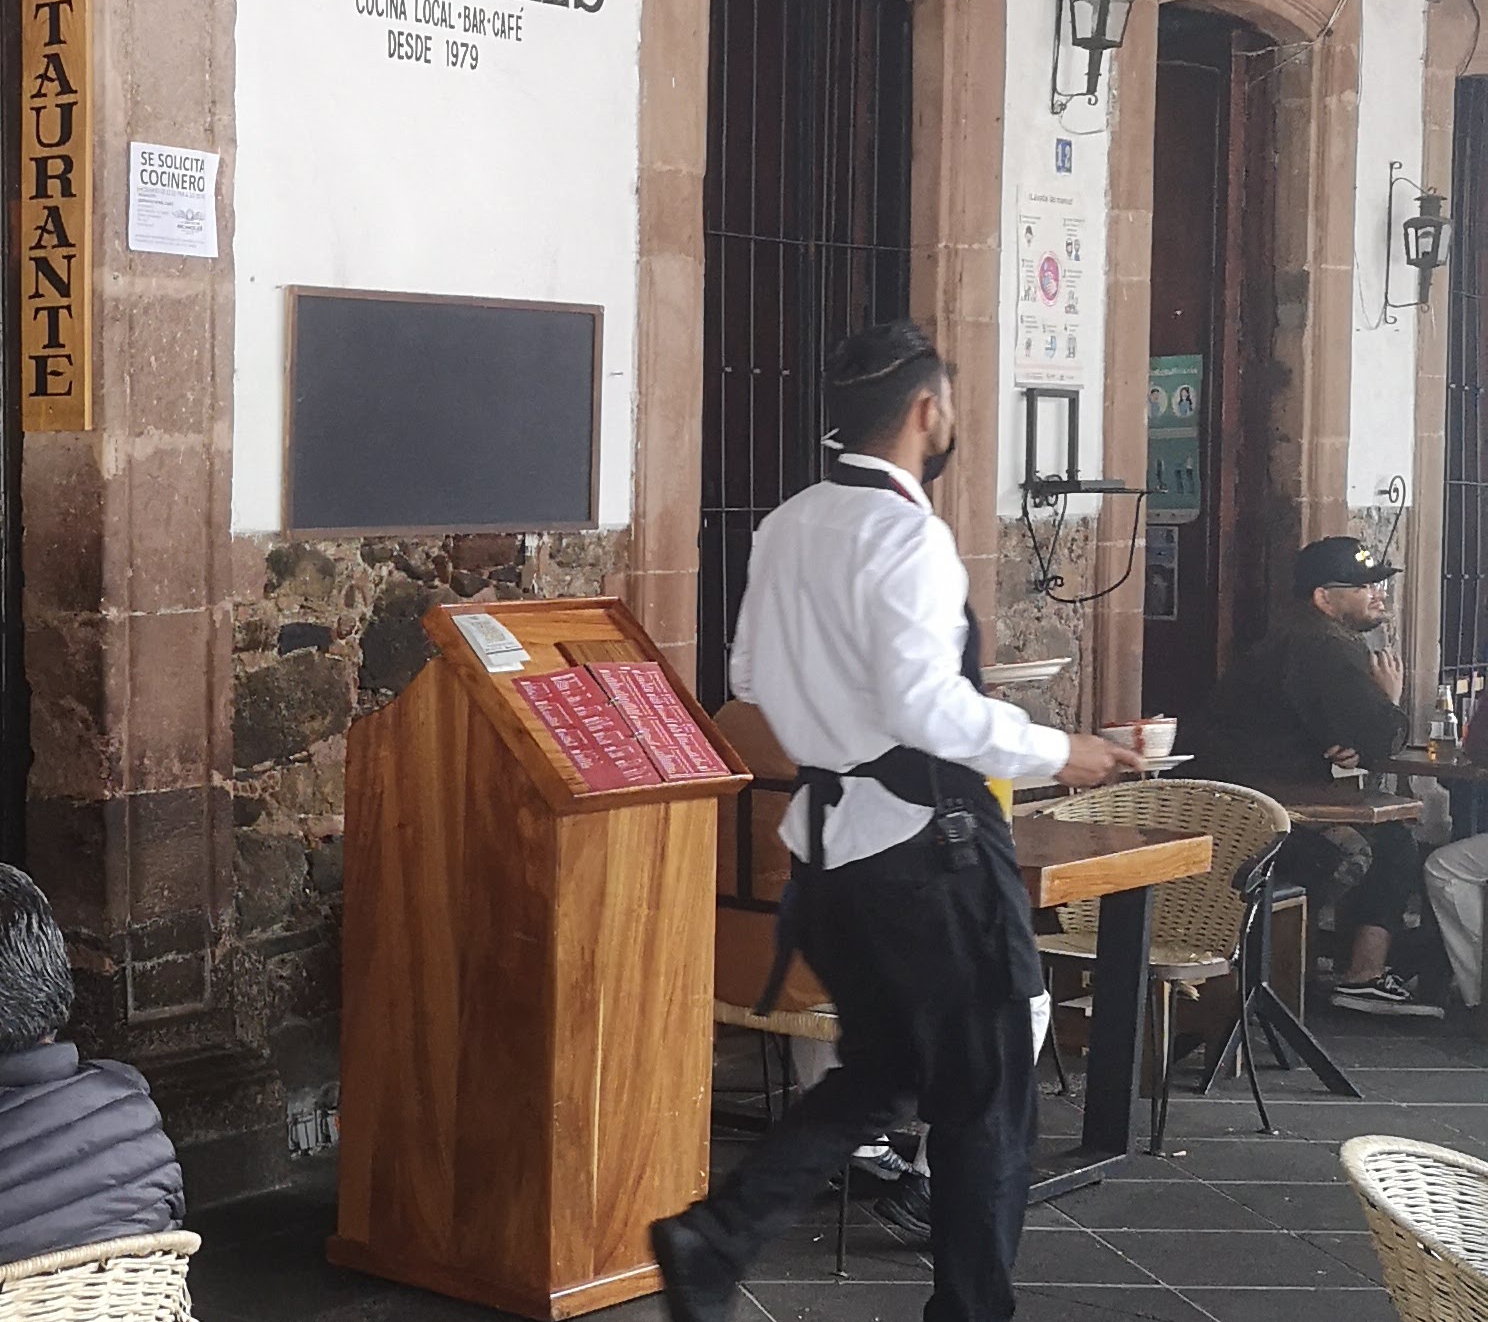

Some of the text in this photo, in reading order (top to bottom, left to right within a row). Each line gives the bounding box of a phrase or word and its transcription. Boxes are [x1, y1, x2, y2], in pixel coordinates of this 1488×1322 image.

[463, 5, 486, 36] BAR
[492, 7, 524, 42] CAFÉ
[388, 29, 479, 70] DESDE 1979
[141, 151, 205, 173] SE SOLICITA
[140, 169, 205, 193] COCINERO
